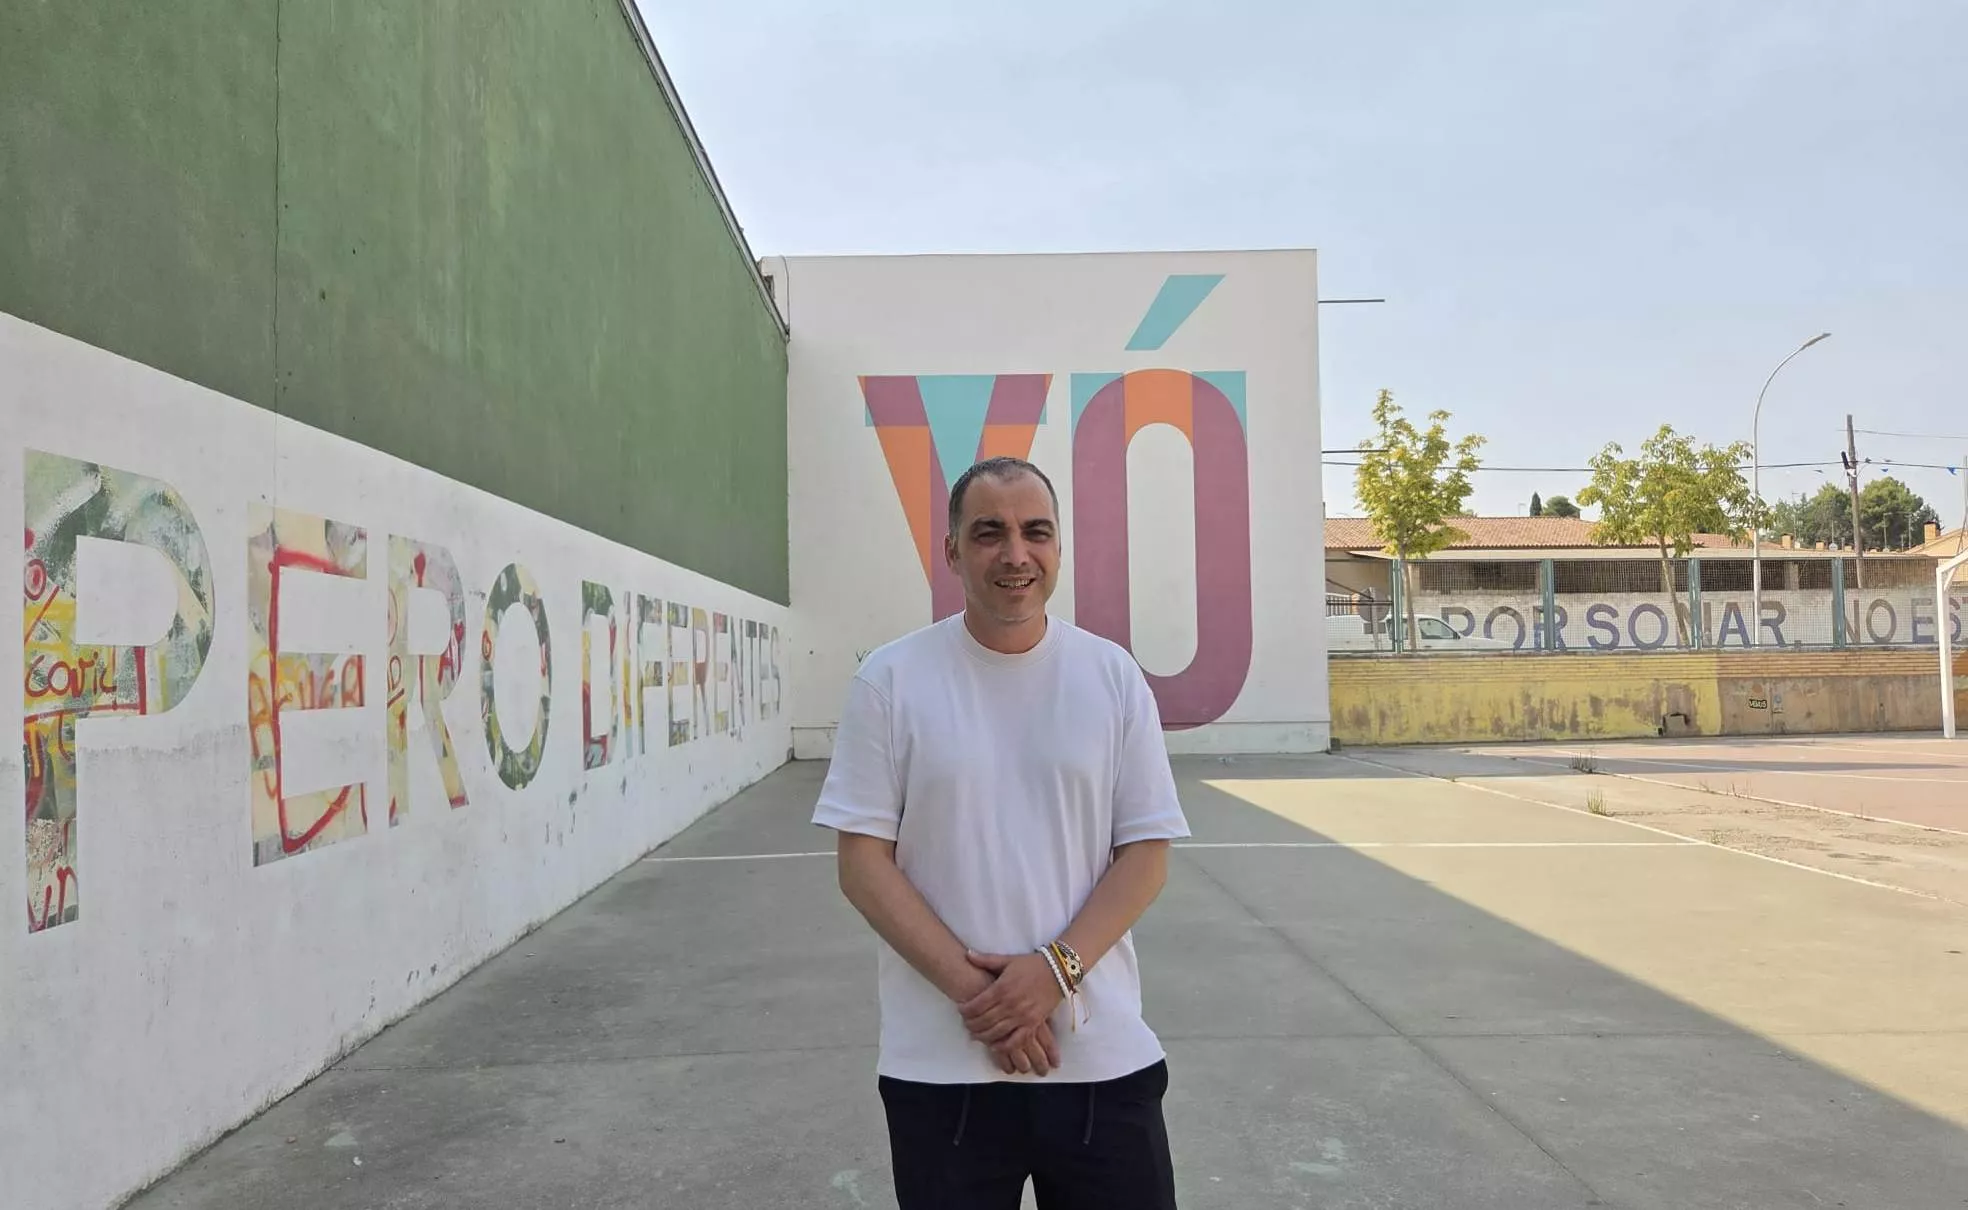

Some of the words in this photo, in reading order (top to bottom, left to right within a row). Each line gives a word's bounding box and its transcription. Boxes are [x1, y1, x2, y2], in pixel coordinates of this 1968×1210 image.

[24, 447, 552, 934] PERO
[582, 580, 781, 770] DIFERENTES
[1440, 605, 1568, 651] POR
